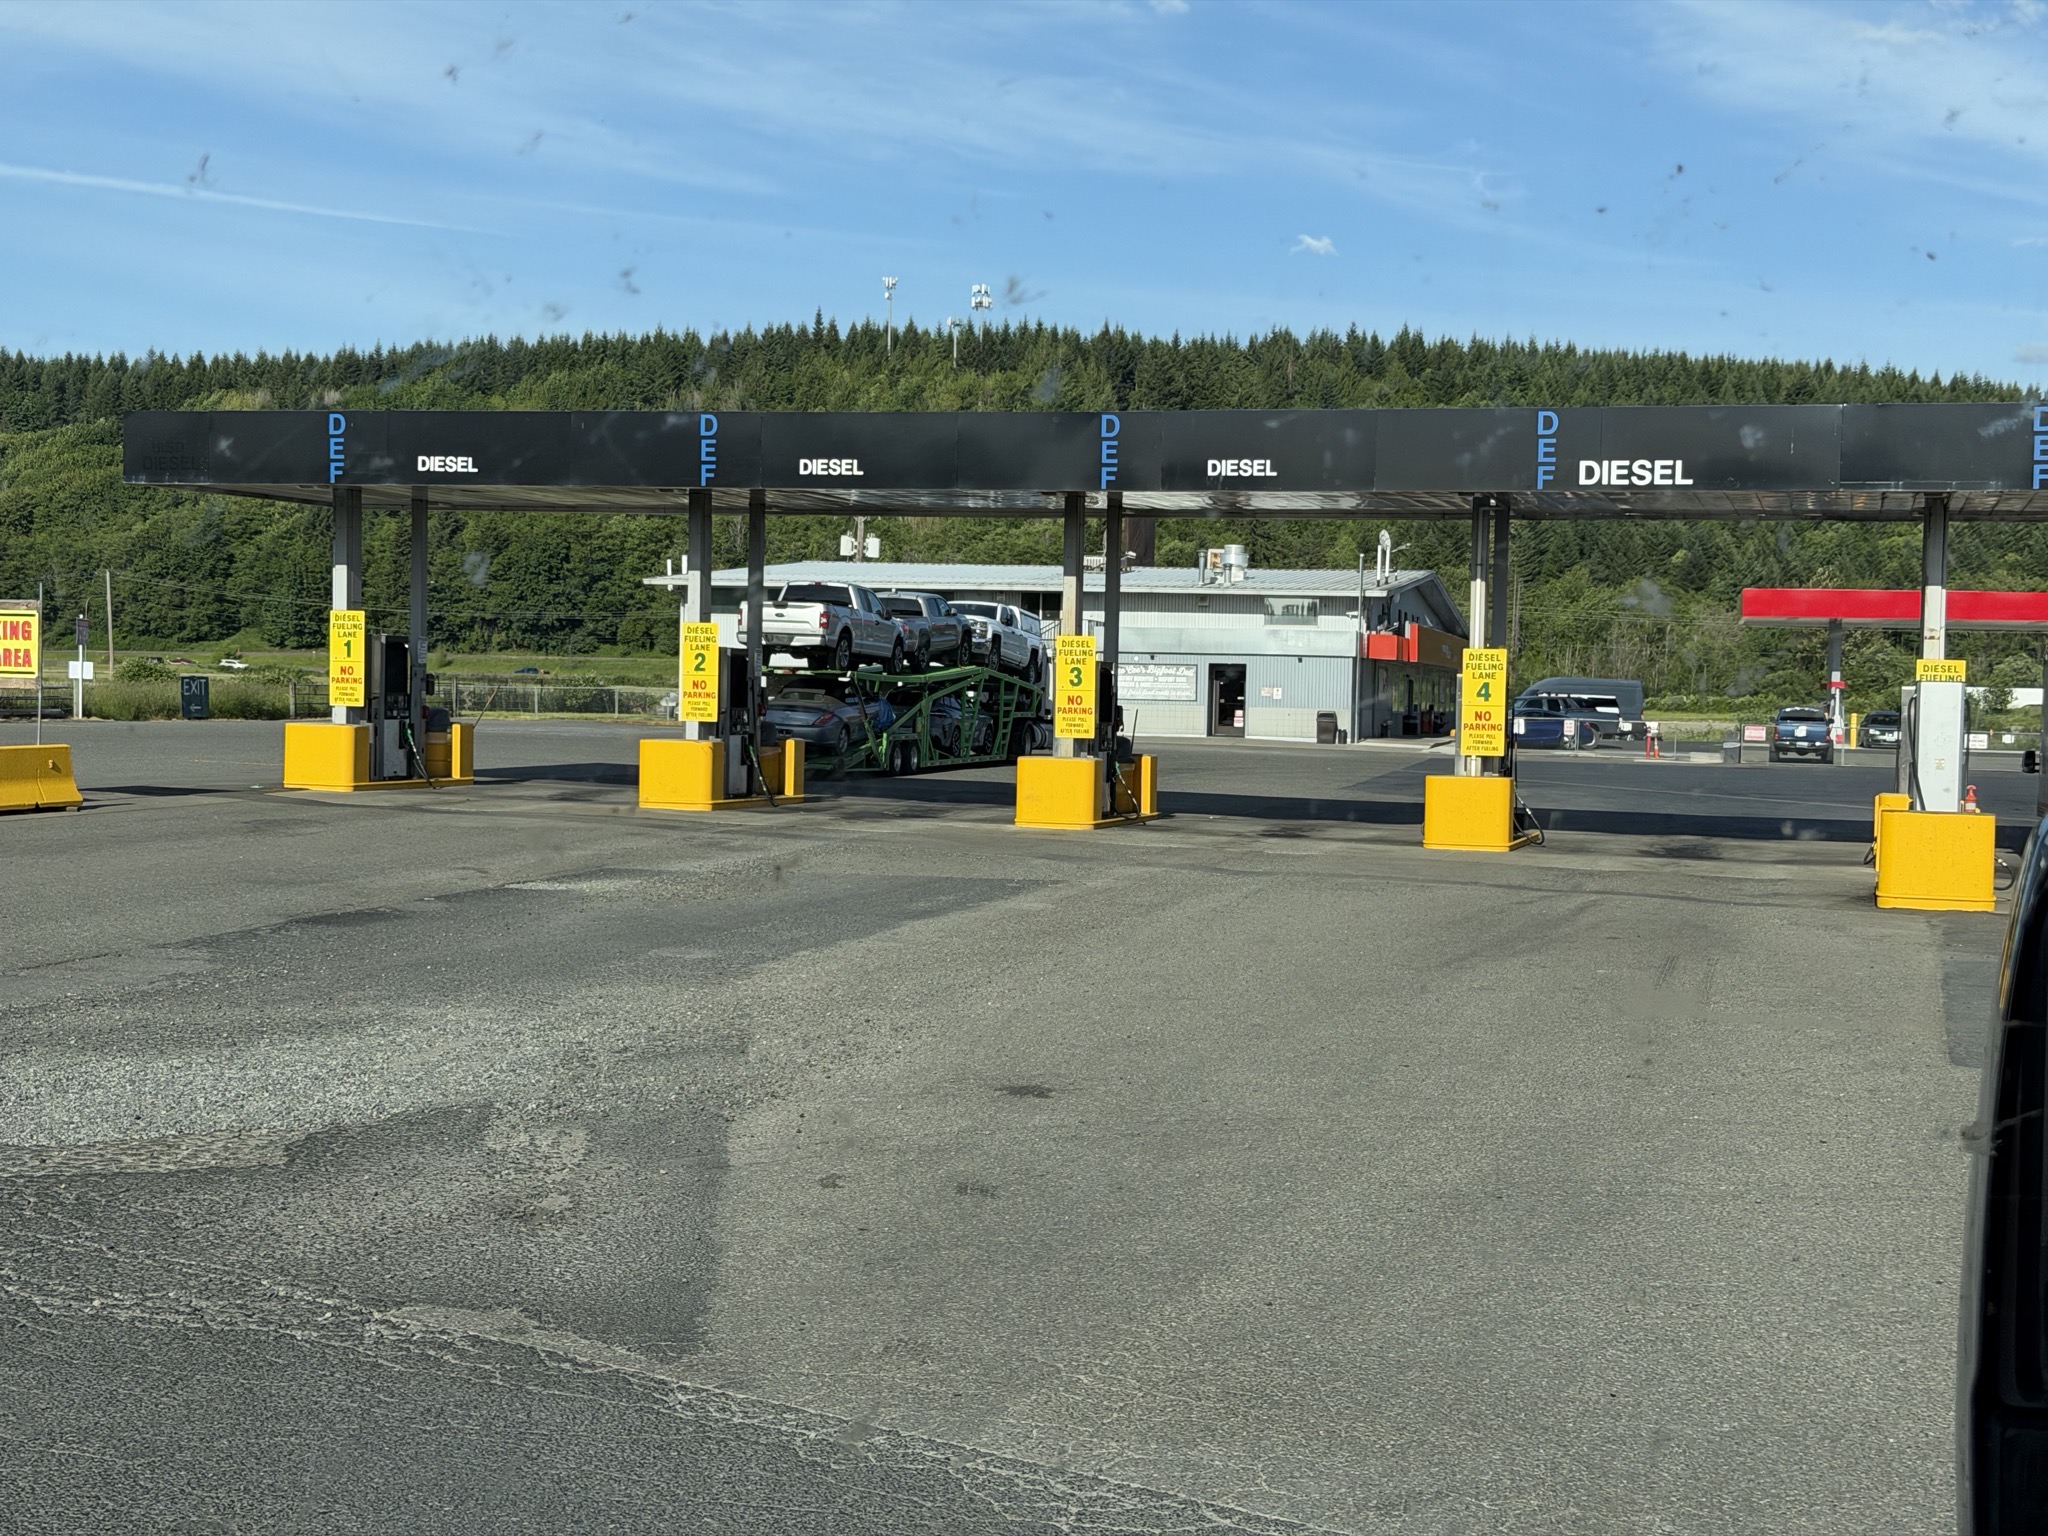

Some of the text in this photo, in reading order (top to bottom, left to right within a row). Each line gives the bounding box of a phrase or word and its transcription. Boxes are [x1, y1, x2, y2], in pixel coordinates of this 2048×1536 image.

[329, 413, 346, 484] DEF
[700, 414, 718, 487] DEF
[1101, 414, 1120, 489] DEF
[1537, 411, 1559, 490] DEF
[2033, 406, 2048, 489] DEF
[143, 455, 200, 471] DIESEL
[417, 455, 478, 473] DIESEL
[799, 458, 864, 476] DIESEL
[1207, 459, 1277, 477] DIESEL
[1578, 459, 1694, 486] DIESEL
[335, 614, 360, 622] DIESEL
[0, 620, 32, 641] ING
[687, 626, 714, 634] DIESEL
[344, 640, 351, 658] 1
[1062, 640, 1091, 648] DIESEL
[694, 652, 706, 671] 2
[1468, 653, 1501, 662] DIESEL
[340, 666, 354, 676] NO
[1146, 665, 1176, 676] Bigfoot
[1176, 666, 1195, 676] Deli
[1472, 672, 1496, 680] LANE
[1923, 664, 1960, 673] DIESEL
[692, 680, 706, 690] NO
[1069, 667, 1082, 687] 3
[1920, 674, 1962, 682] FUELING
[183, 679, 207, 695] EXIT
[683, 691, 716, 699] PARKING
[1476, 682, 1492, 702] 4
[1067, 695, 1083, 706] NO
[1057, 707, 1093, 715] PARKING
[1474, 710, 1492, 722] NO
[1463, 723, 1502, 732] PARKING
